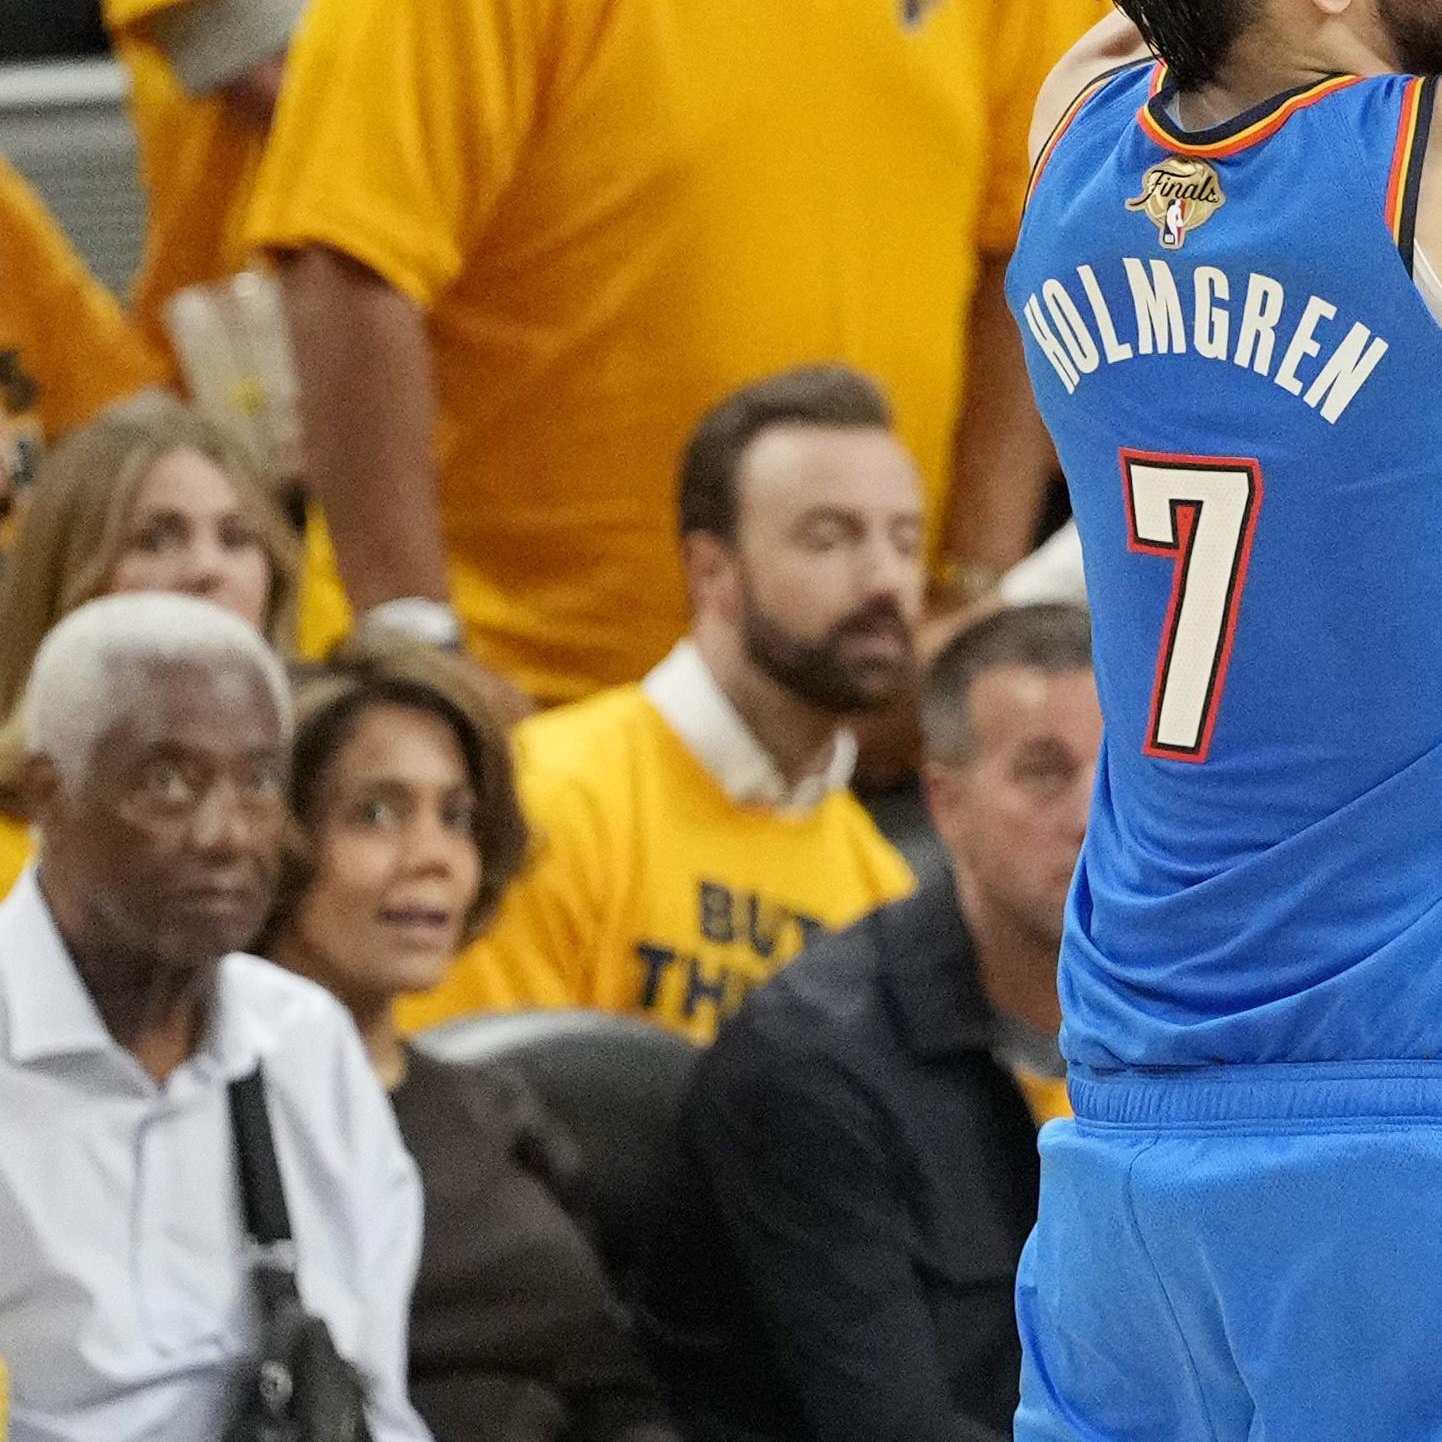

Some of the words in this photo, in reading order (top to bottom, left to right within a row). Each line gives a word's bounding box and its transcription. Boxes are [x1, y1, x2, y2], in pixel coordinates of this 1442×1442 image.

[1128, 169, 1220, 204] Finals
[1023, 257, 1389, 425] HOLMGREN
[1117, 446, 1264, 764] 7
